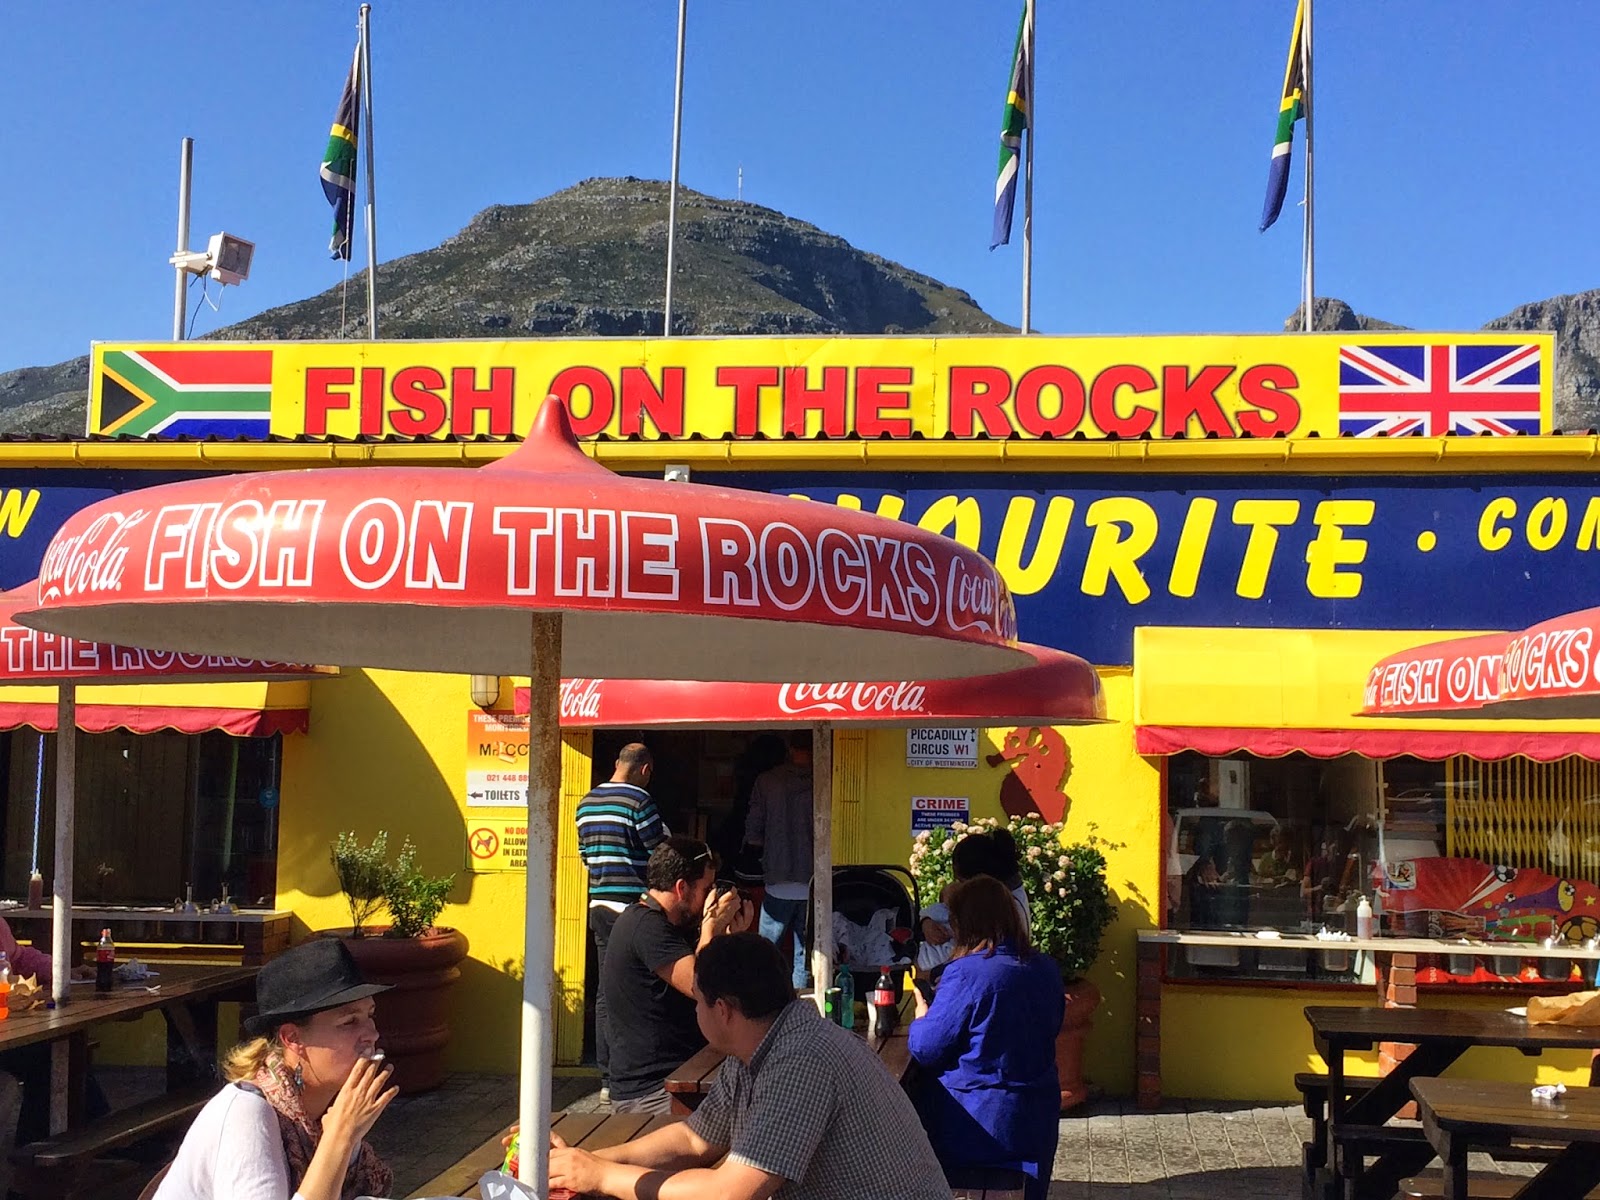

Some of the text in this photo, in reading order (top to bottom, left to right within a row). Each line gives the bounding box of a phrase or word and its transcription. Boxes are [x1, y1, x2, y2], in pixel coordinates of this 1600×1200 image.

[304, 363, 1302, 438] FISH ON THE ROCKS
[144, 499, 327, 592] FISH
[339, 497, 474, 590] ON
[493, 506, 679, 600] THE
[698, 517, 940, 627] ROCKS
[1, 626, 100, 671] THE
[1381, 659, 1443, 706] FISH
[1447, 655, 1503, 702] ON
[911, 729, 967, 741] PICCADILLY
[911, 743, 969, 755] CIRCUS W1
[485, 790, 520, 801] TOILETS
[916, 799, 966, 809] CRIME
[504, 827, 515, 835] NO
[503, 848, 510, 856] IN
